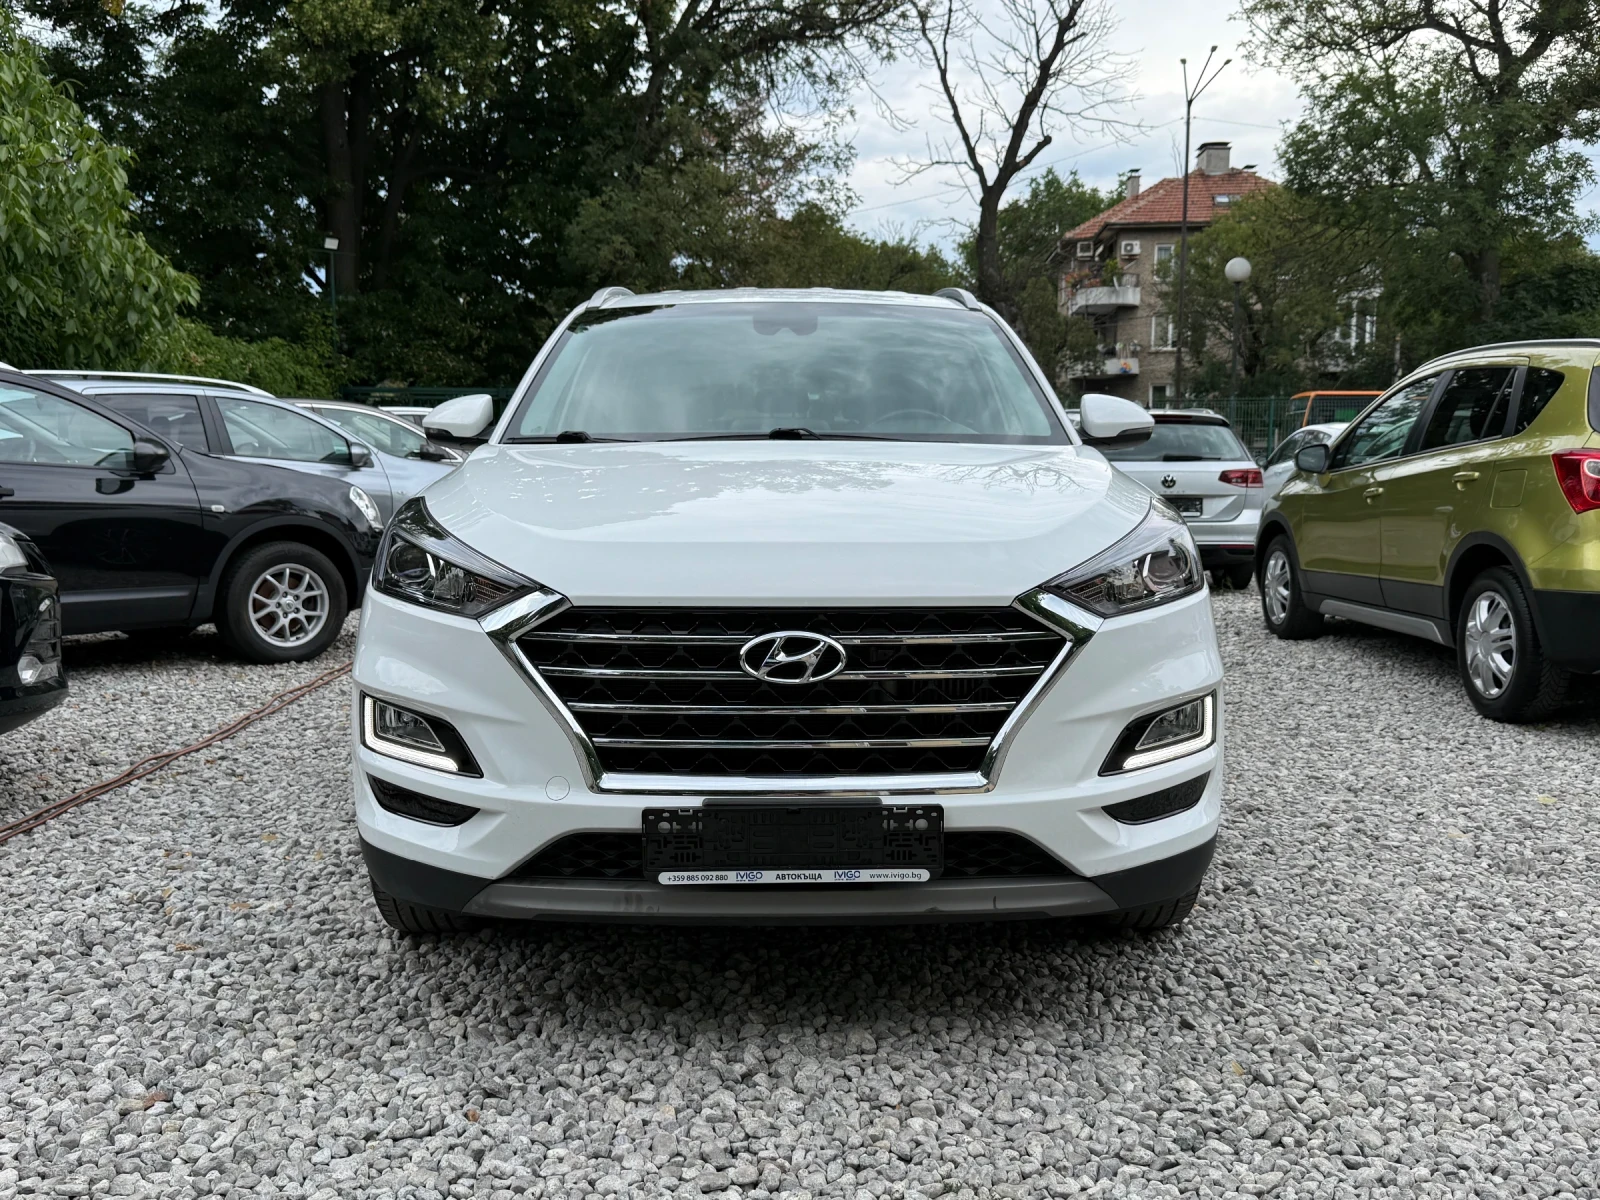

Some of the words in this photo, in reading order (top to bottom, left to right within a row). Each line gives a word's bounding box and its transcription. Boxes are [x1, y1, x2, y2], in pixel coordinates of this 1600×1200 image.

[667, 874, 685, 882] +359
[735, 871, 763, 880] IVIGO
[775, 873, 822, 881] АВТОКЪЩА
[833, 870, 861, 879] IVIGO
[869, 871, 922, 880] www.ivigo.bg
